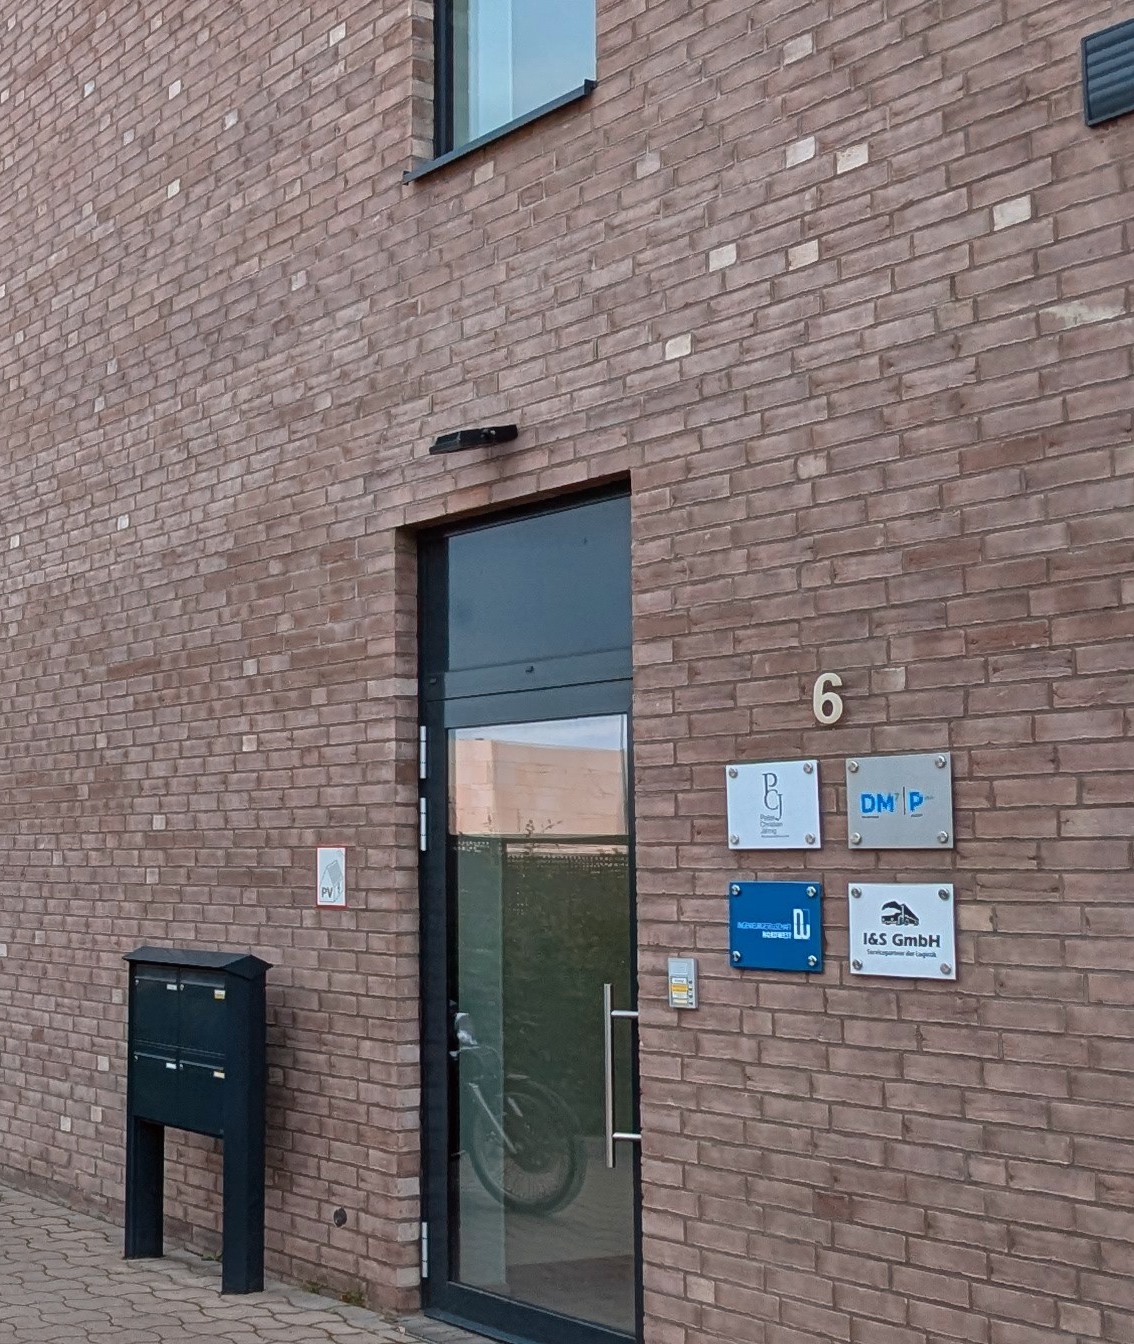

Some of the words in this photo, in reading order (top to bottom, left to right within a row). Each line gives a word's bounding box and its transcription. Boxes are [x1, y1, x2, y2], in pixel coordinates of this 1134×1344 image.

[813, 672, 843, 724] 6
[321, 886, 333, 898] PV
[863, 932, 887, 946] I&S
[892, 933, 941, 948] GmbH
